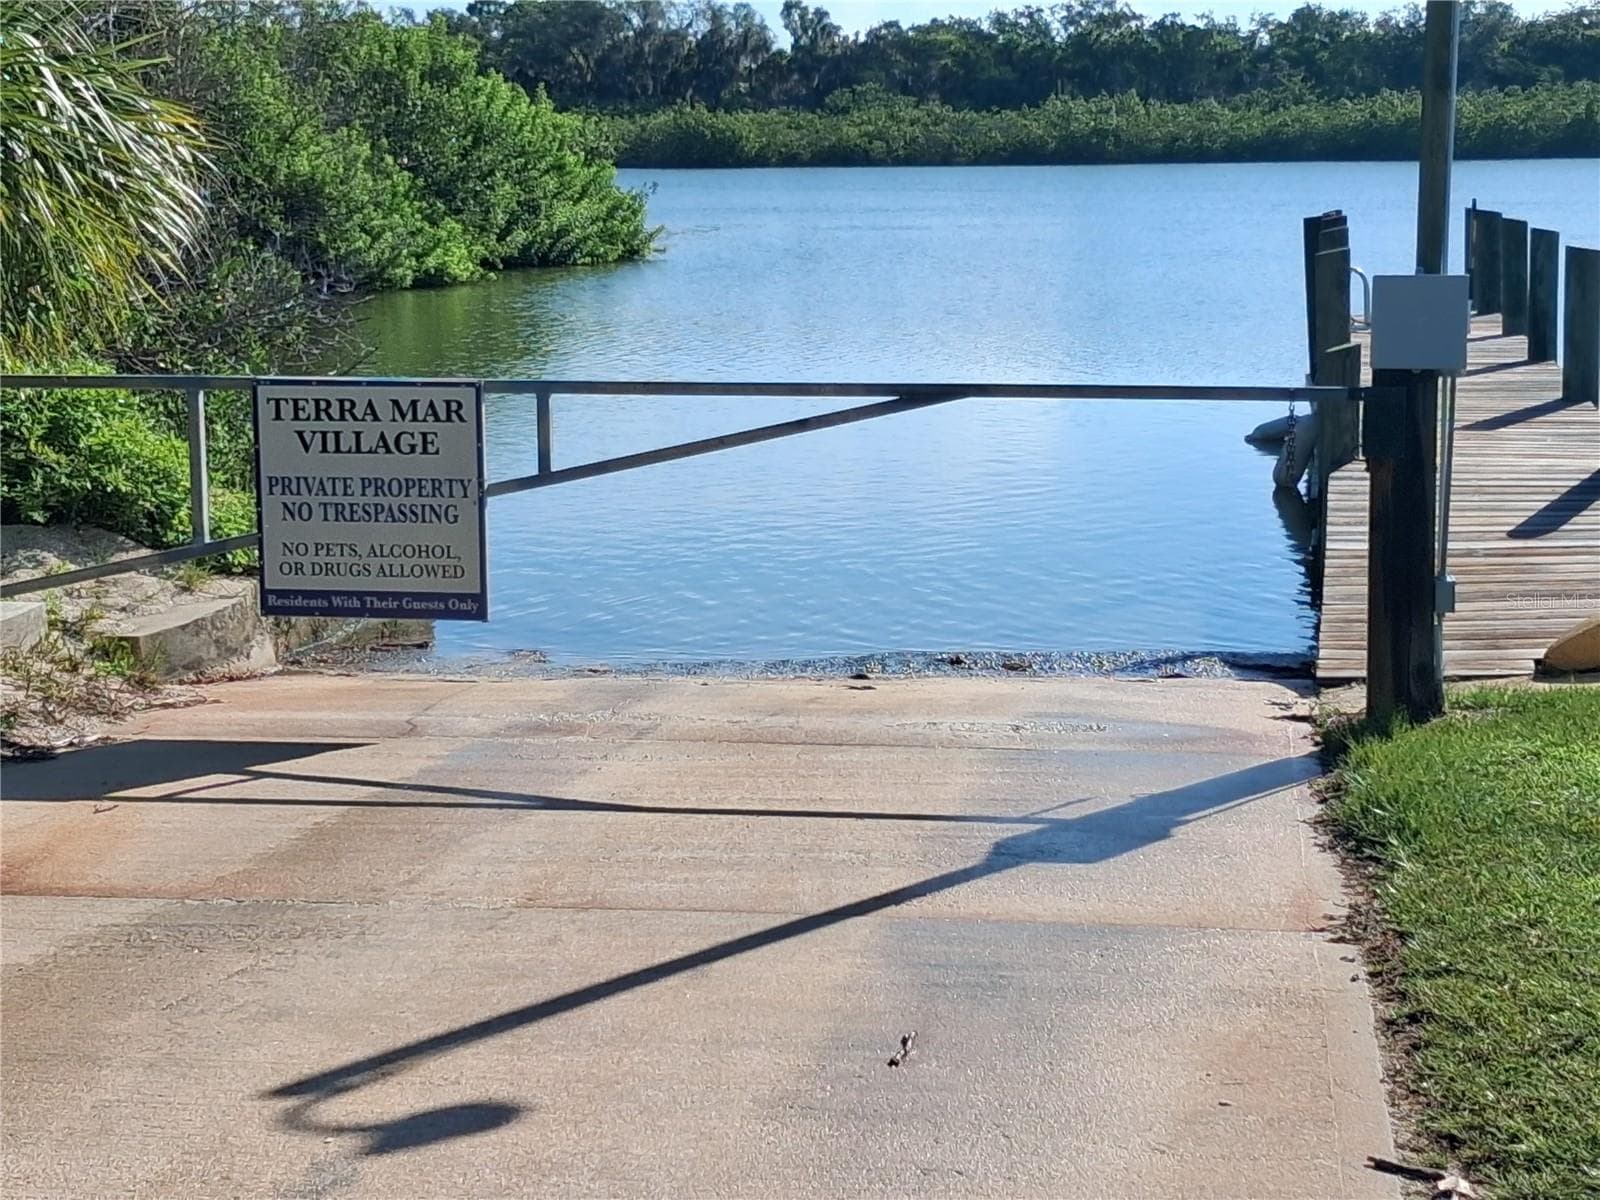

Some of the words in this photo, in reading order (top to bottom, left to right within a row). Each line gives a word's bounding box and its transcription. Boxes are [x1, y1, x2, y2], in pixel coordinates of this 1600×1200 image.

[267, 398, 382, 422] TERRA
[389, 399, 467, 423] MAR
[294, 430, 440, 455] VILLAGE
[267, 476, 354, 497] PRIVATE
[360, 477, 472, 498] PROPERTY
[281, 502, 312, 522] NO
[319, 503, 459, 524] TRESPASSING
[282, 542, 308, 556] NO
[314, 543, 362, 560] PETS,
[367, 544, 462, 561] ALCOHOL,
[279, 562, 309, 576] OR
[311, 562, 371, 577] DRUGS
[376, 564, 465, 579] ALLOWED
[267, 594, 328, 607] Residents
[331, 596, 361, 608] With
[366, 596, 399, 608] Their
[402, 598, 445, 610] Guests
[450, 599, 479, 613] Only
